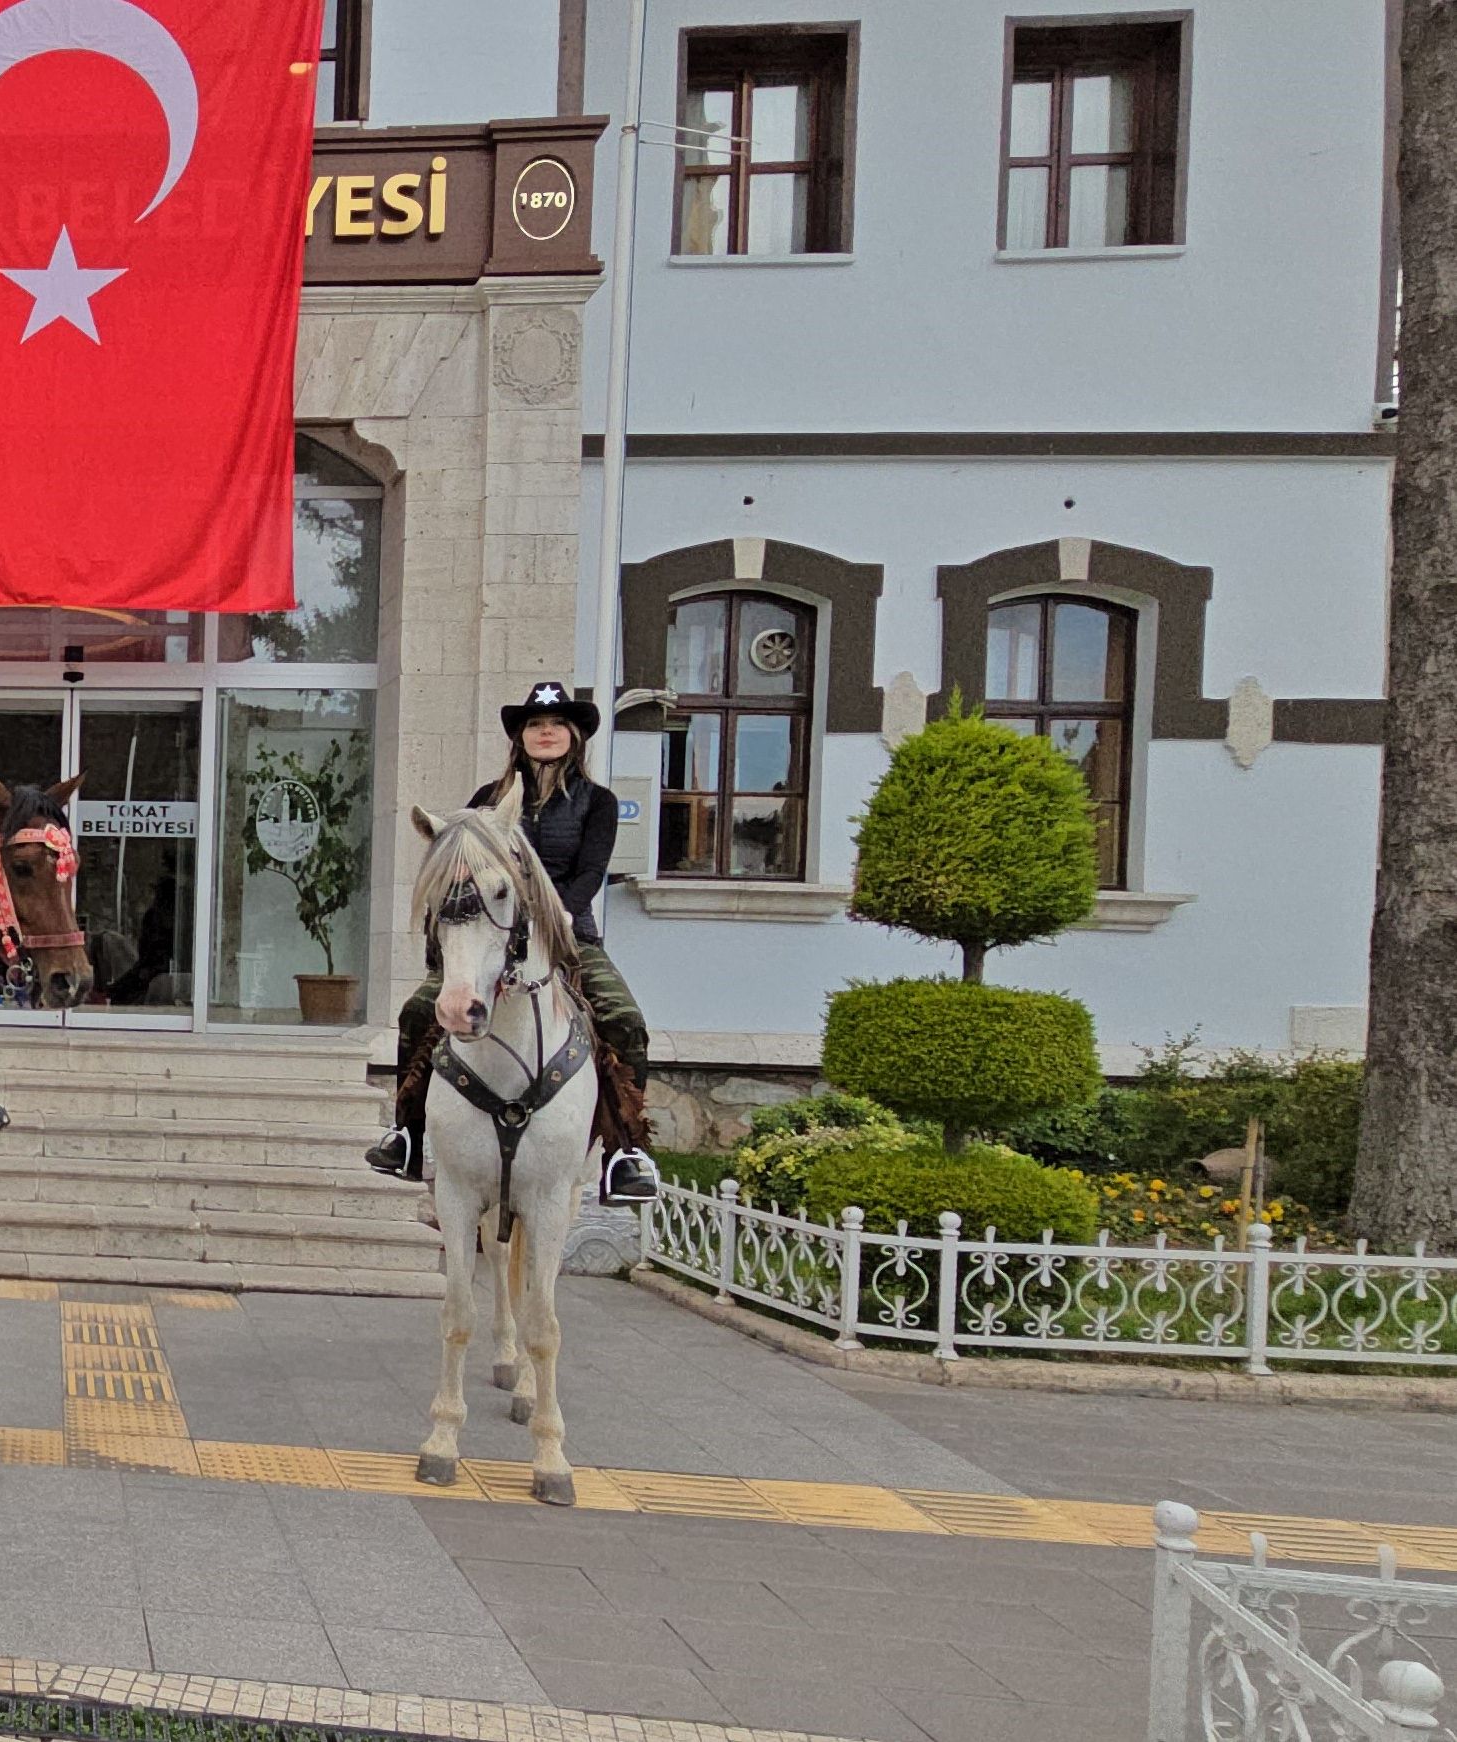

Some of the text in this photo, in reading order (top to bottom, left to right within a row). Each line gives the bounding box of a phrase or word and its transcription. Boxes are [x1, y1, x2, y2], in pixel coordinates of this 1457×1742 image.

[519, 191, 568, 209] 1870
[106, 804, 171, 818] TOKAT
[82, 819, 194, 835] BELEDİYESİ
